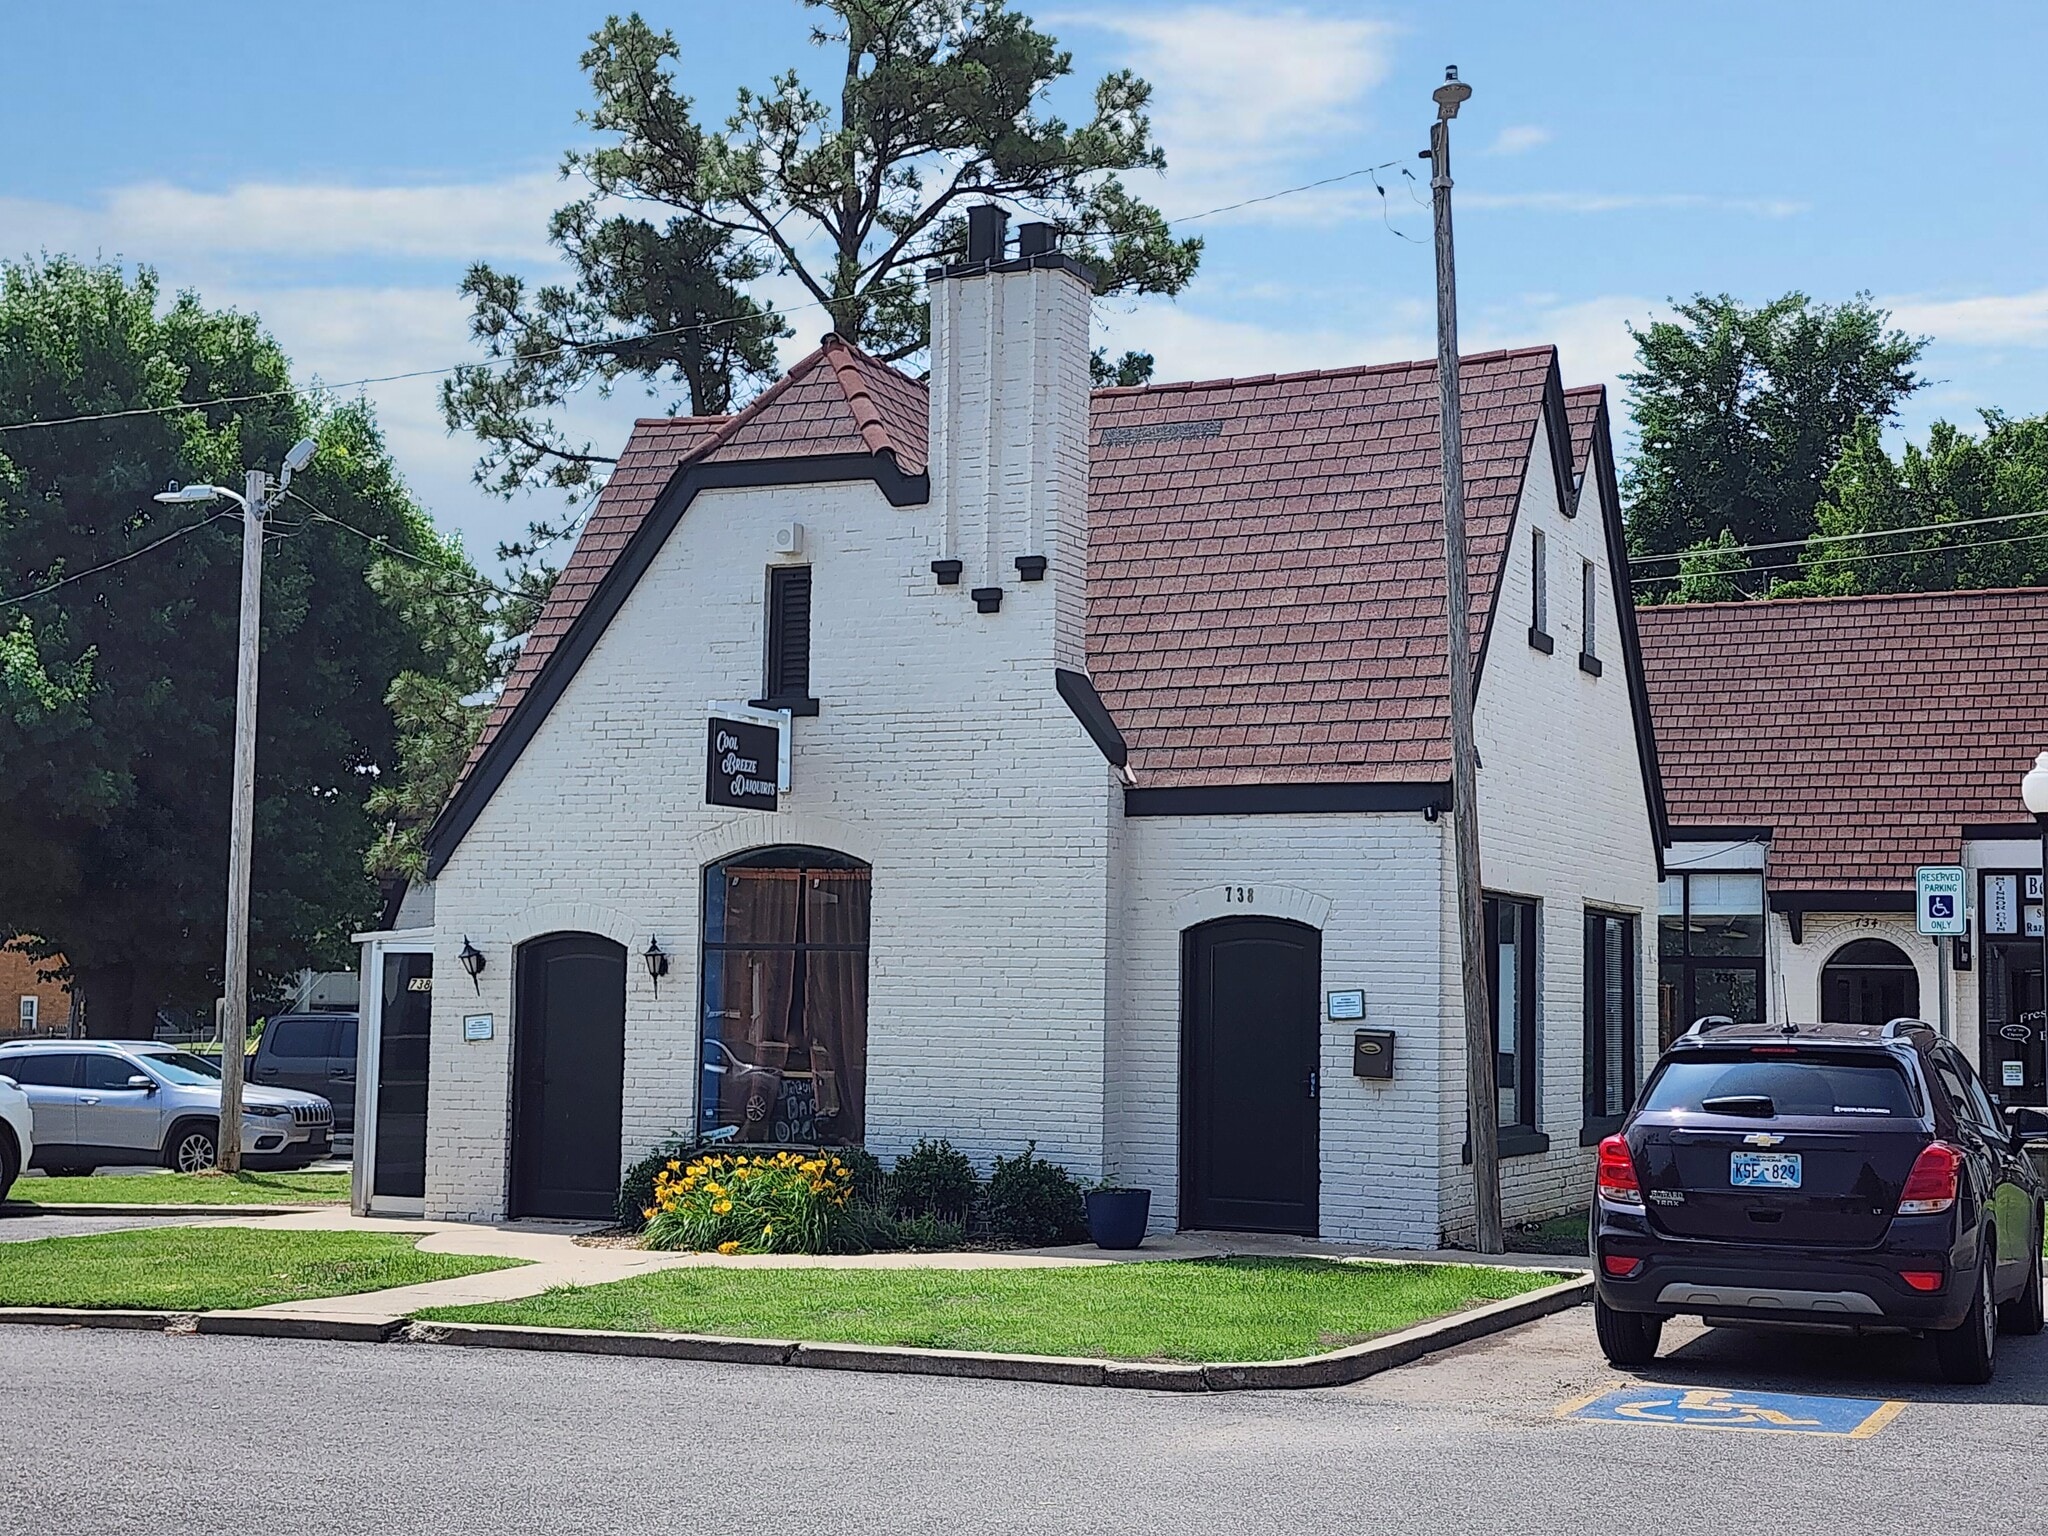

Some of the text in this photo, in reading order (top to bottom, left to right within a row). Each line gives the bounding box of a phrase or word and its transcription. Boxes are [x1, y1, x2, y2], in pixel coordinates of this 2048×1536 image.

[1921, 873, 1960, 882] RESERVED
[1925, 884, 1957, 892] PARKING
[1225, 887, 1254, 903] 738
[1931, 921, 1951, 930] ONLY
[1715, 973, 1737, 982] 736
[410, 979, 431, 990] 738
